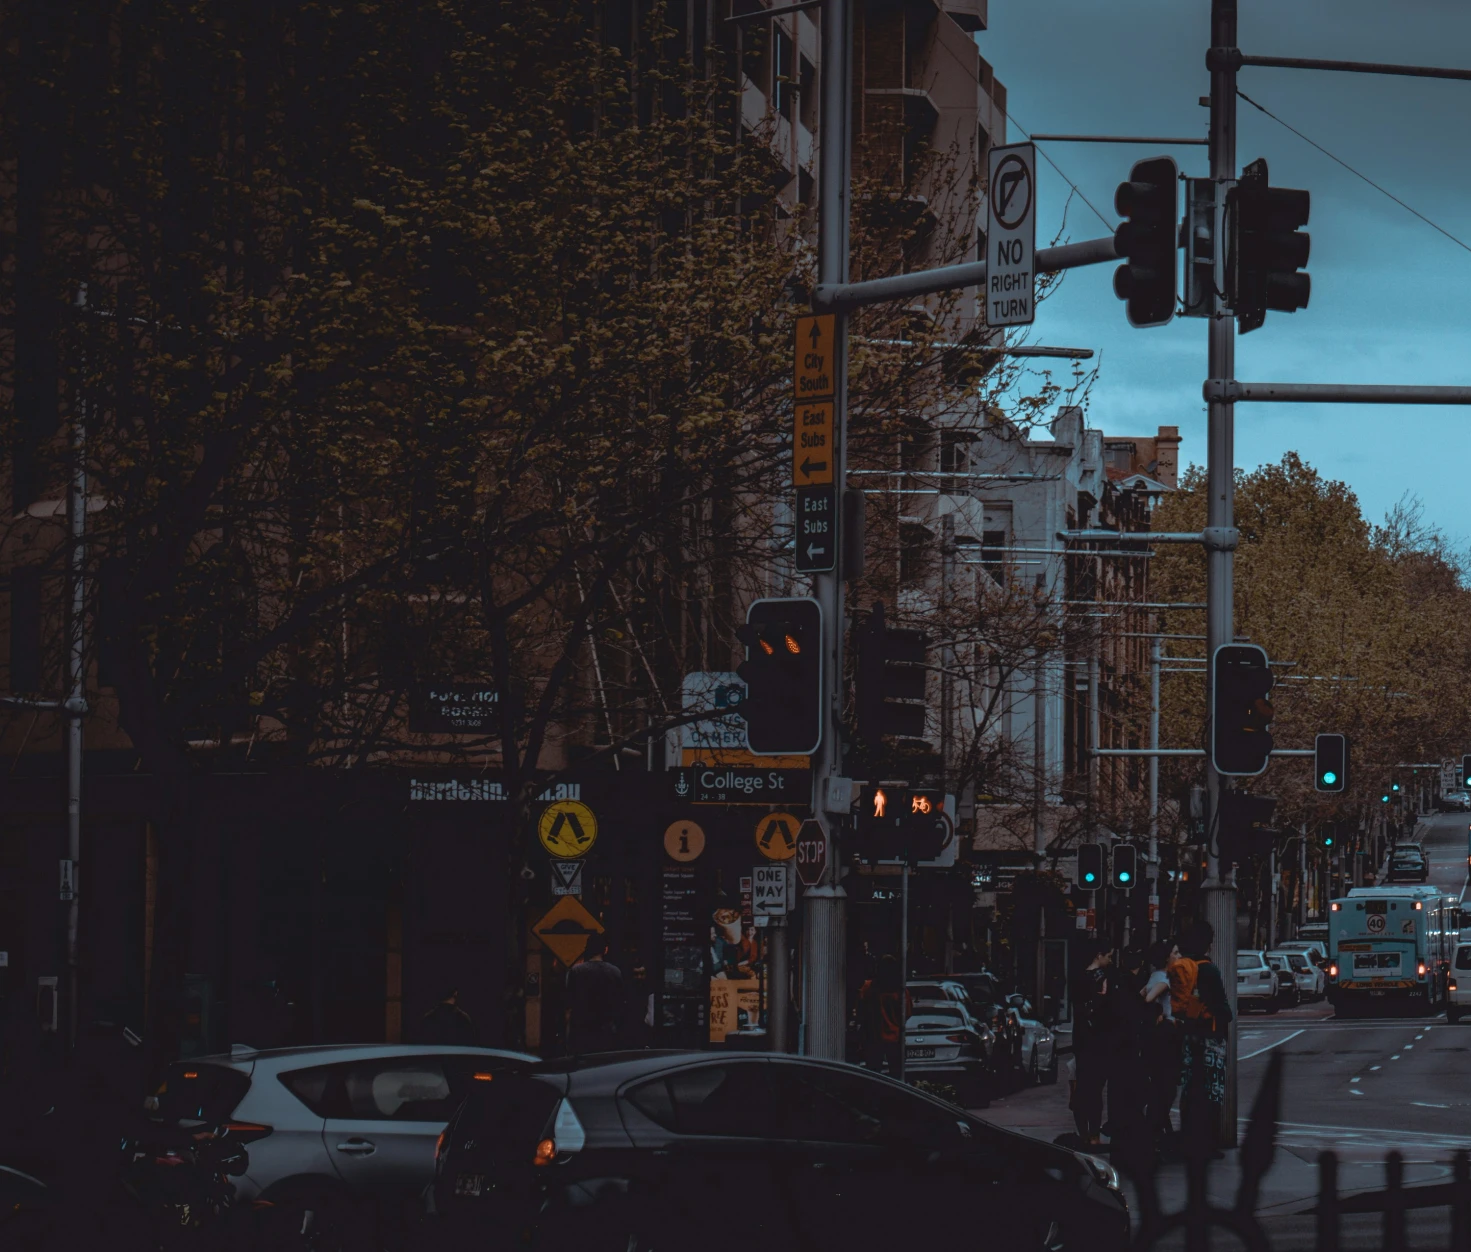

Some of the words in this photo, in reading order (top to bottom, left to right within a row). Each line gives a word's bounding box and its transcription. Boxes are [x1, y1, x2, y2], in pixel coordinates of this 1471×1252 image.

[998, 239, 1023, 267] NO
[991, 272, 1029, 293] RIGHT
[993, 299, 1028, 319] TURN
[804, 352, 824, 371] City
[799, 375, 829, 393] South
[803, 409, 826, 426] East
[801, 431, 826, 449] Subs
[804, 497, 828, 513] East
[803, 519, 828, 534] Subs
[701, 771, 763, 794] College
[768, 772, 785, 789] St
[798, 841, 824, 864] STOP
[757, 870, 782, 882] ONE
[755, 885, 784, 898] WAY
[1369, 919, 1384, 929] 40
